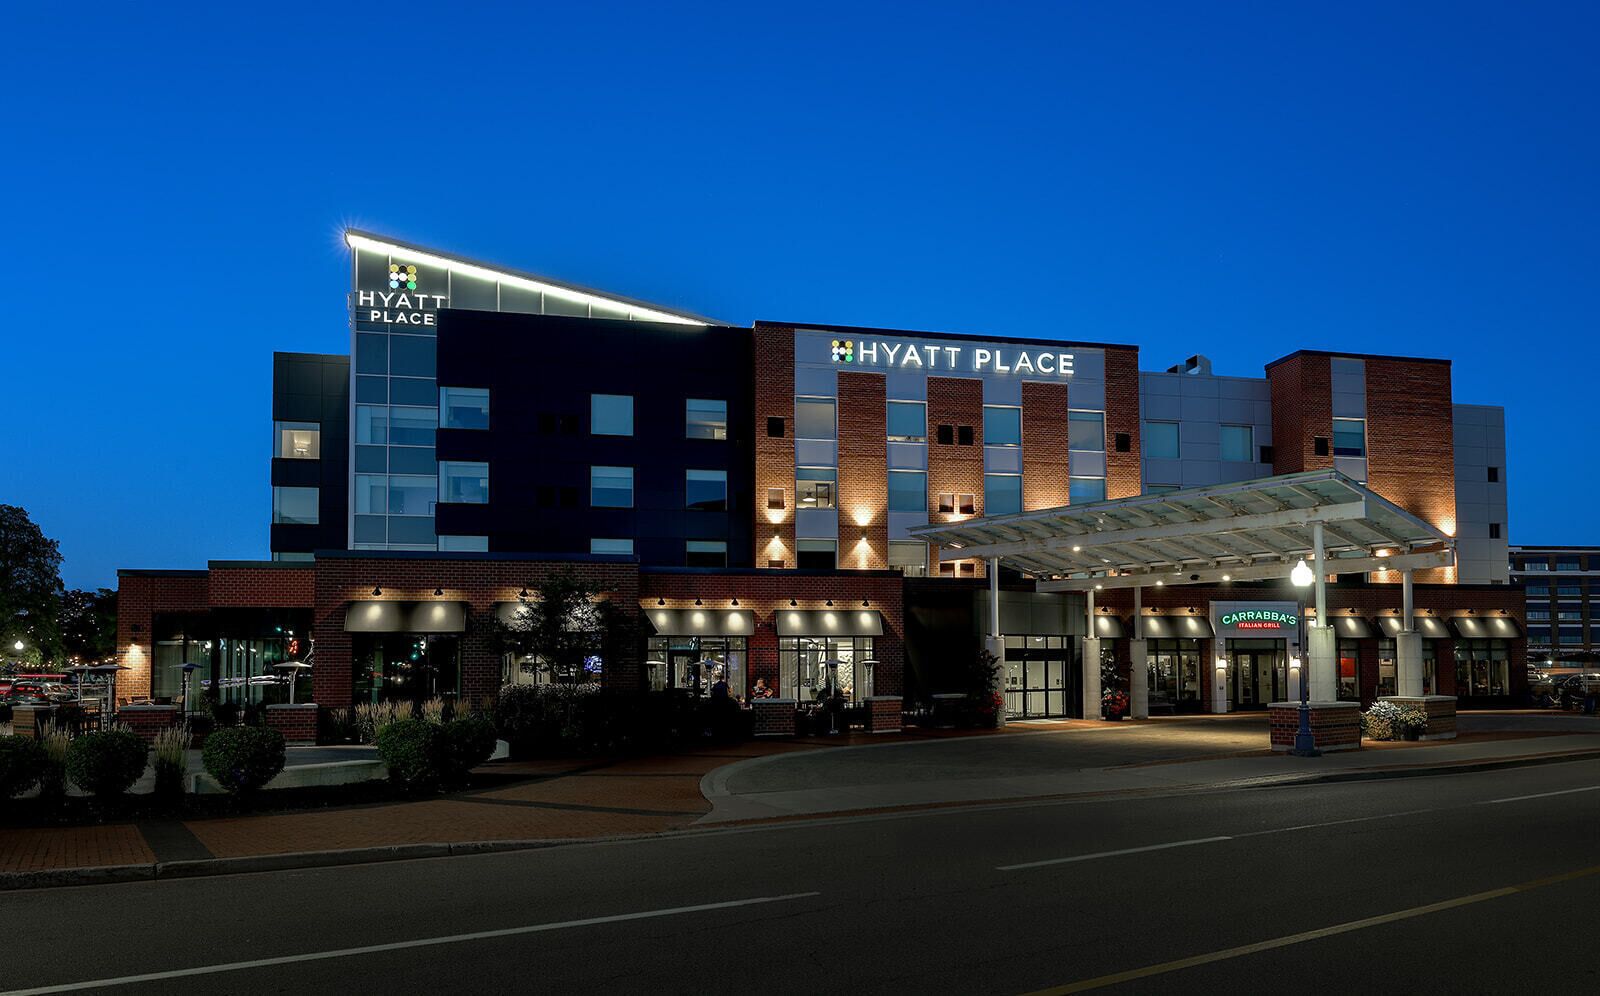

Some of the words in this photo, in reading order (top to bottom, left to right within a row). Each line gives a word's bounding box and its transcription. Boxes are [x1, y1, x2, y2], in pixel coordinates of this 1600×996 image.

[359, 290, 446, 310] HYATT
[370, 310, 434, 326] PLACE
[858, 341, 961, 368] HYATT
[975, 349, 1075, 375] PLACE
[1222, 611, 1297, 625] CARRABBA'S
